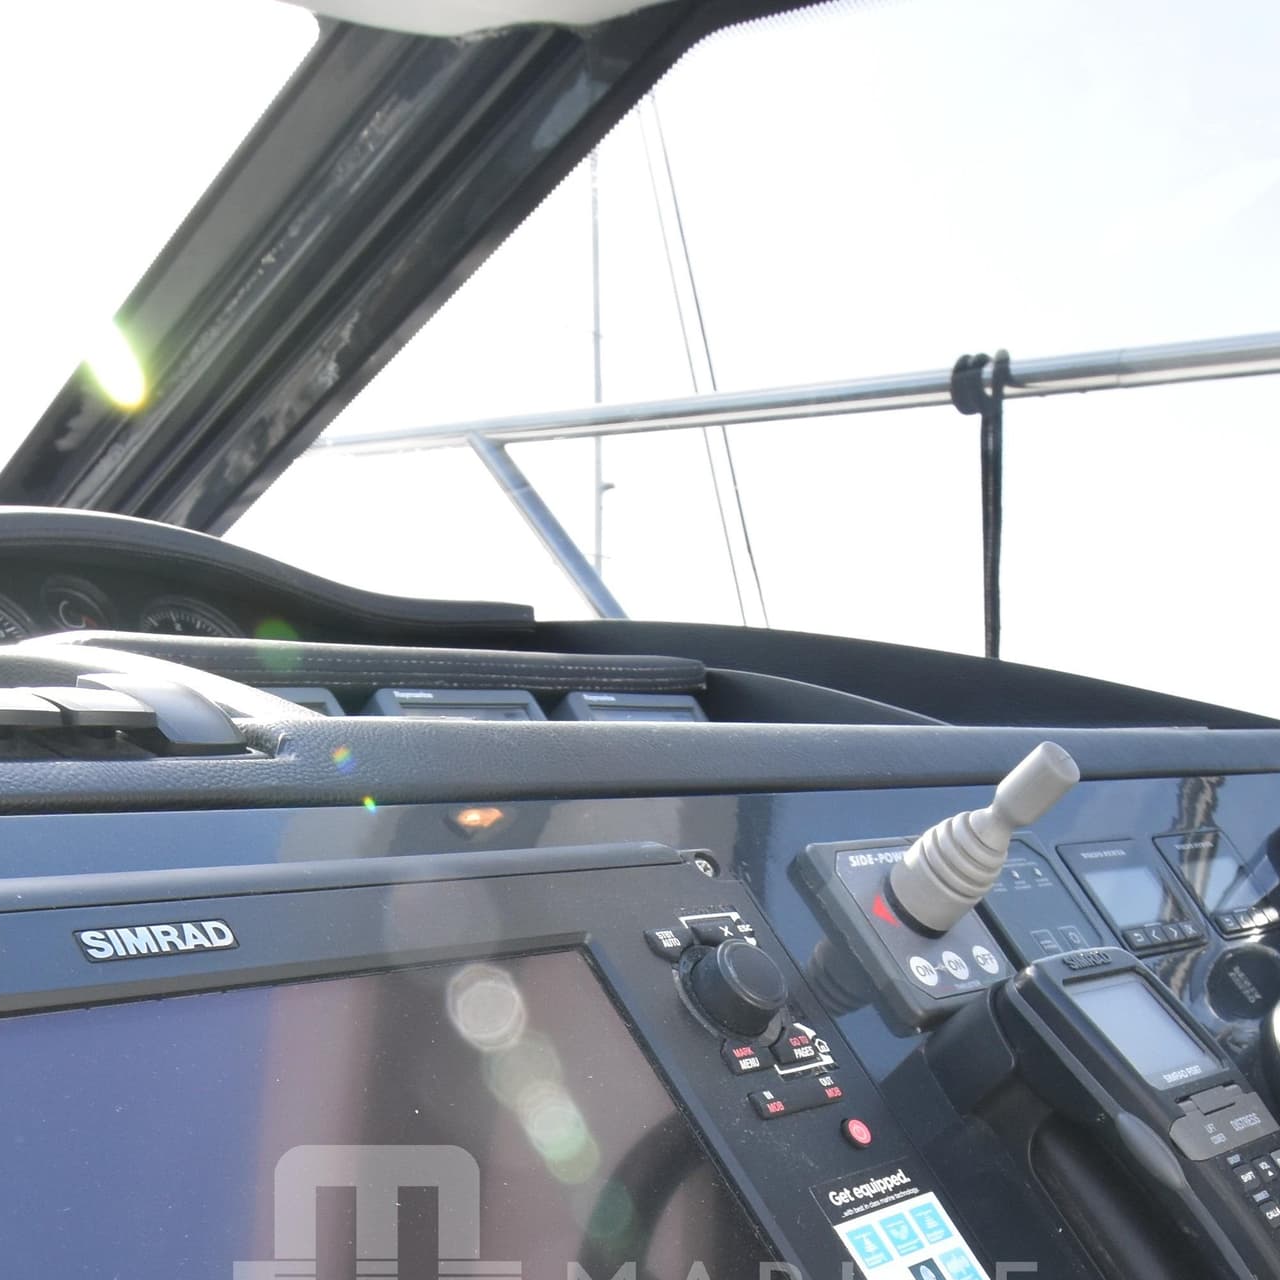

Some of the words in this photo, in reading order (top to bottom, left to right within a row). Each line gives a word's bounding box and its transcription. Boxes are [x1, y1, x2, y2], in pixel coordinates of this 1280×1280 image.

[80, 920, 235, 959] SIMRAD
[948, 959, 967, 972] ON
[975, 952, 996, 967] OFF
[915, 964, 934, 977] ON
[732, 1047, 755, 1059] MARK
[793, 1045, 815, 1060] PAGES
[739, 1057, 760, 1070] MENU
[1230, 1112, 1262, 1132] DISTRESS
[828, 1187, 855, 1206] Get
[852, 1168, 911, 1198] equipped.
